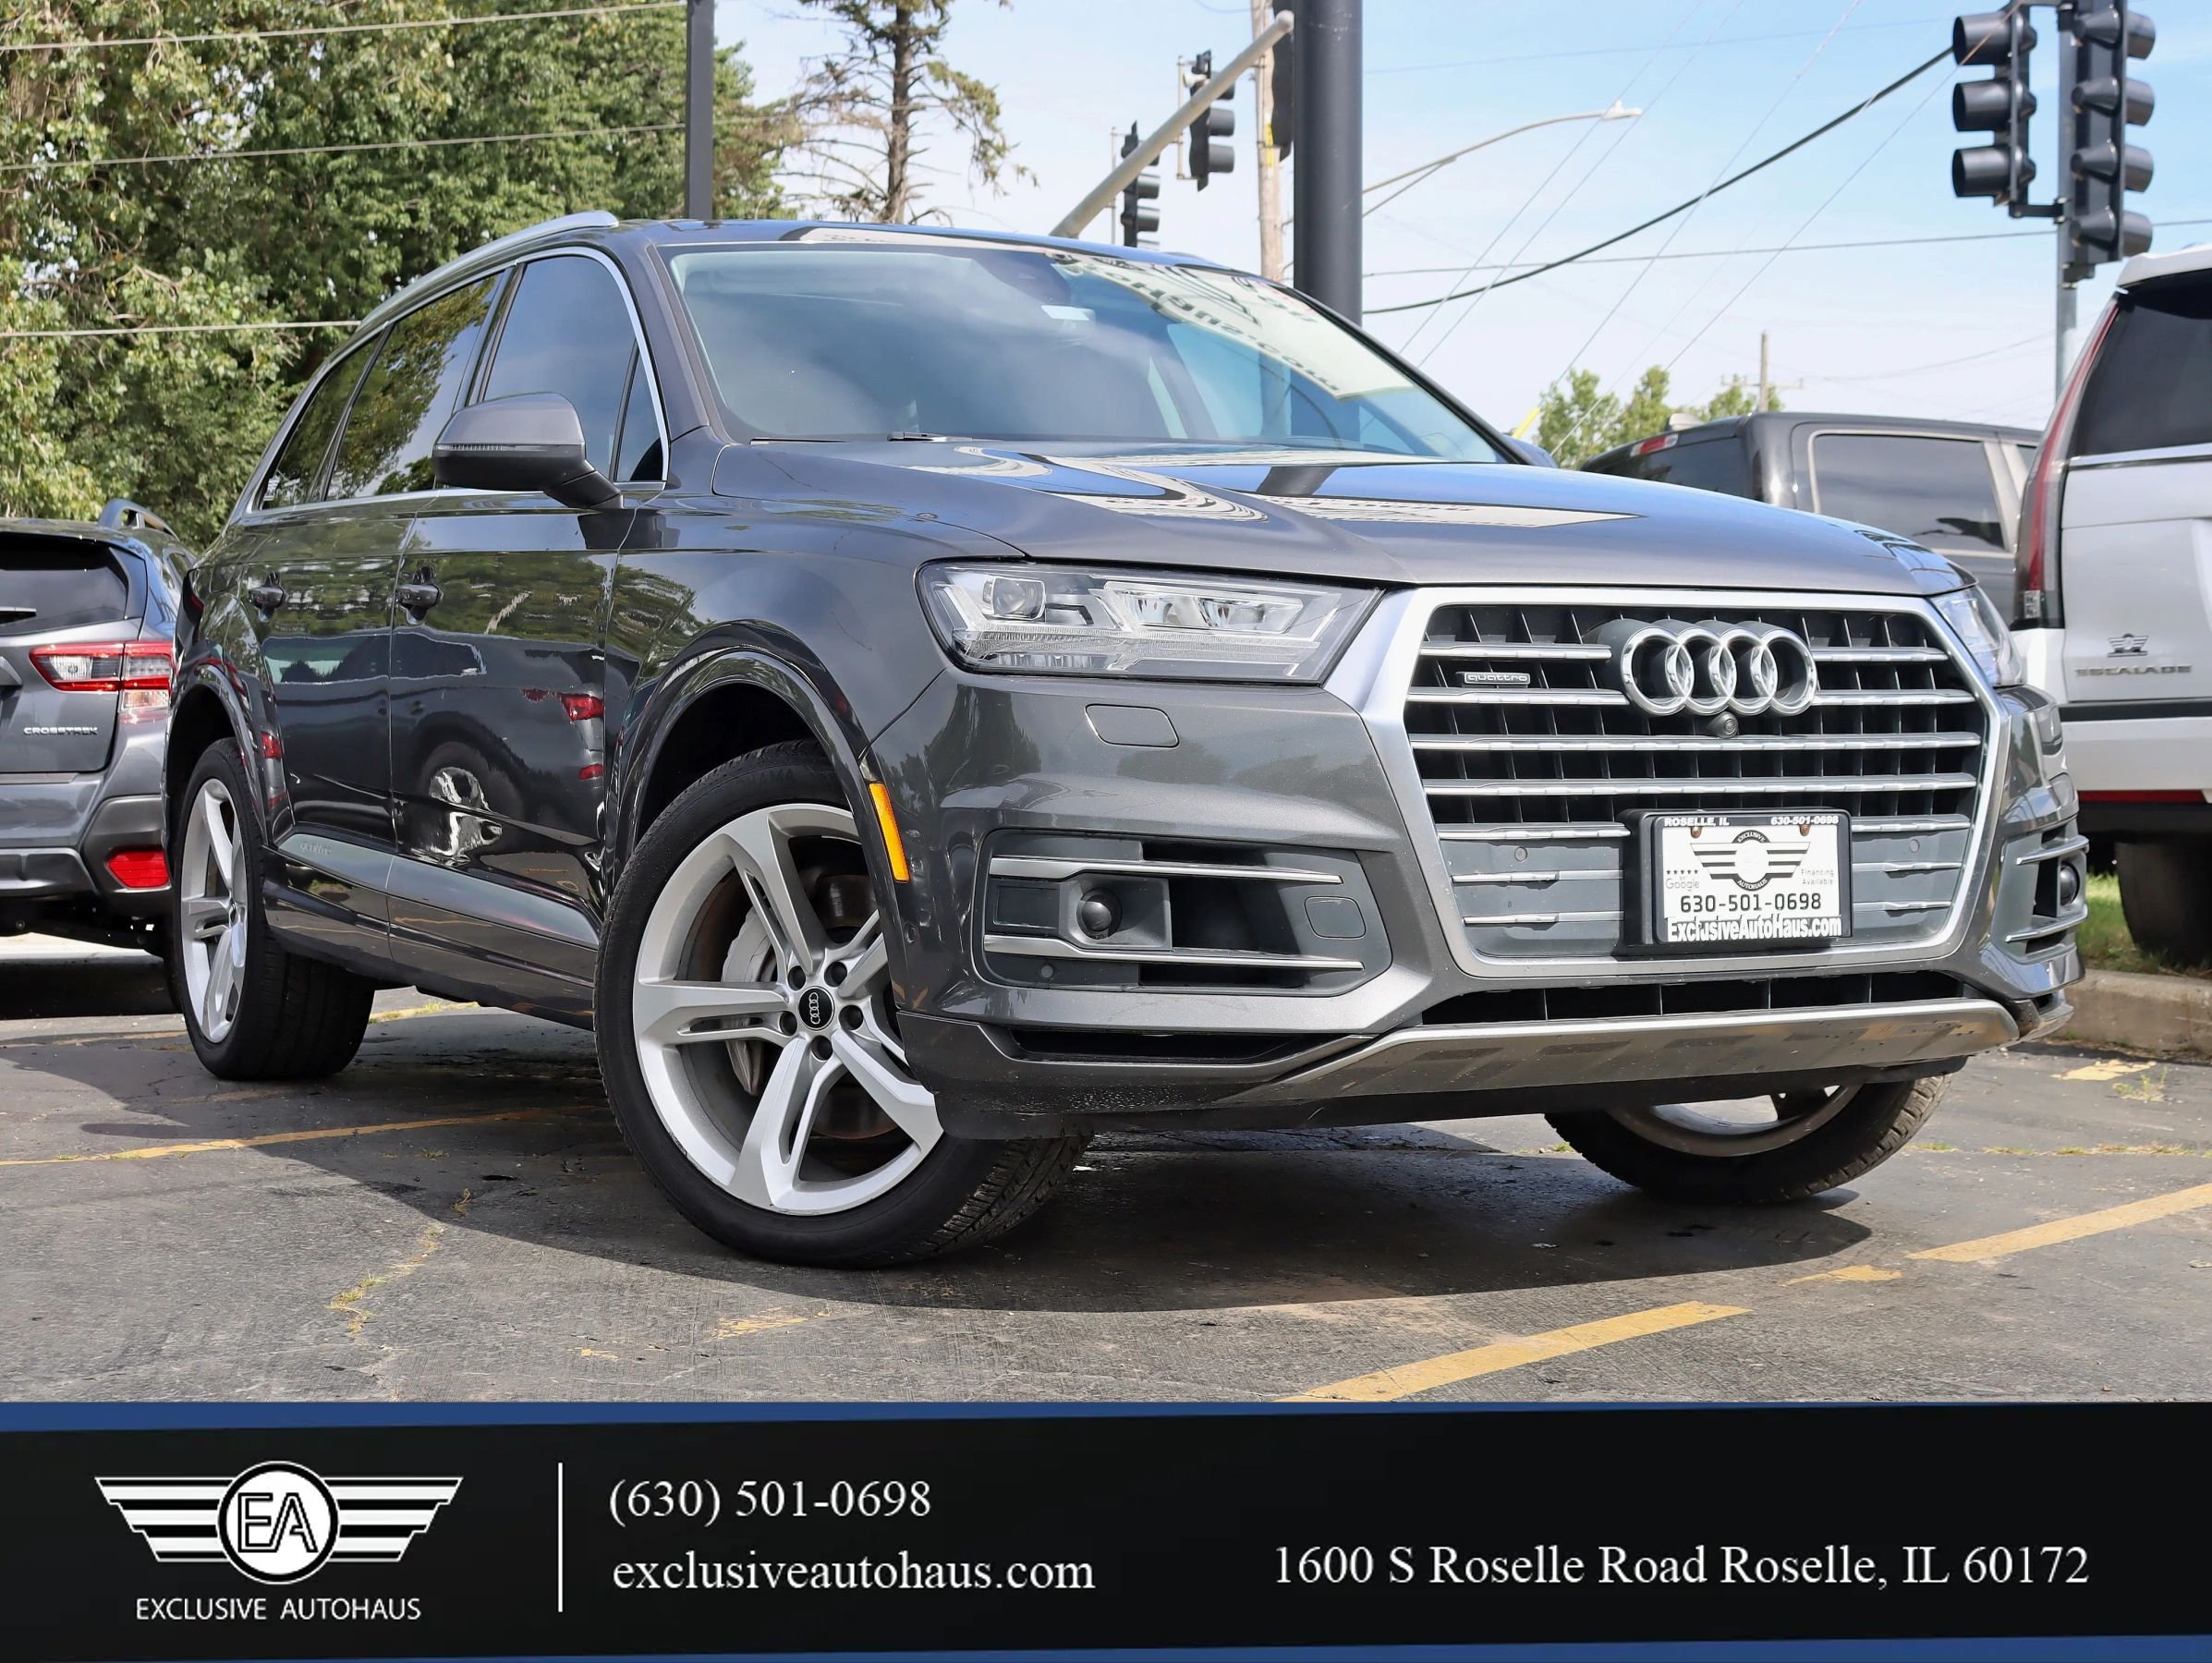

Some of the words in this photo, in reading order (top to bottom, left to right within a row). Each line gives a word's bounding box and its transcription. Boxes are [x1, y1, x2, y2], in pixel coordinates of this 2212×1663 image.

[2075, 664, 2193, 676] ESCALADE
[1467, 674, 1528, 682] quattro
[23, 726, 99, 735] CROSSTREK
[1664, 817, 1717, 827] ROSELLE,
[1719, 817, 1730, 826] IL
[1770, 815, 1839, 825] 630-501-0698
[1737, 832, 1766, 843] EXCLUSIVE
[1666, 878, 1699, 891] Google
[1737, 879, 1768, 890] AUTOHAUS
[1681, 892, 1821, 913] 630-501-0698
[1668, 914, 1841, 941] ExclusiveAutoHaus.com
